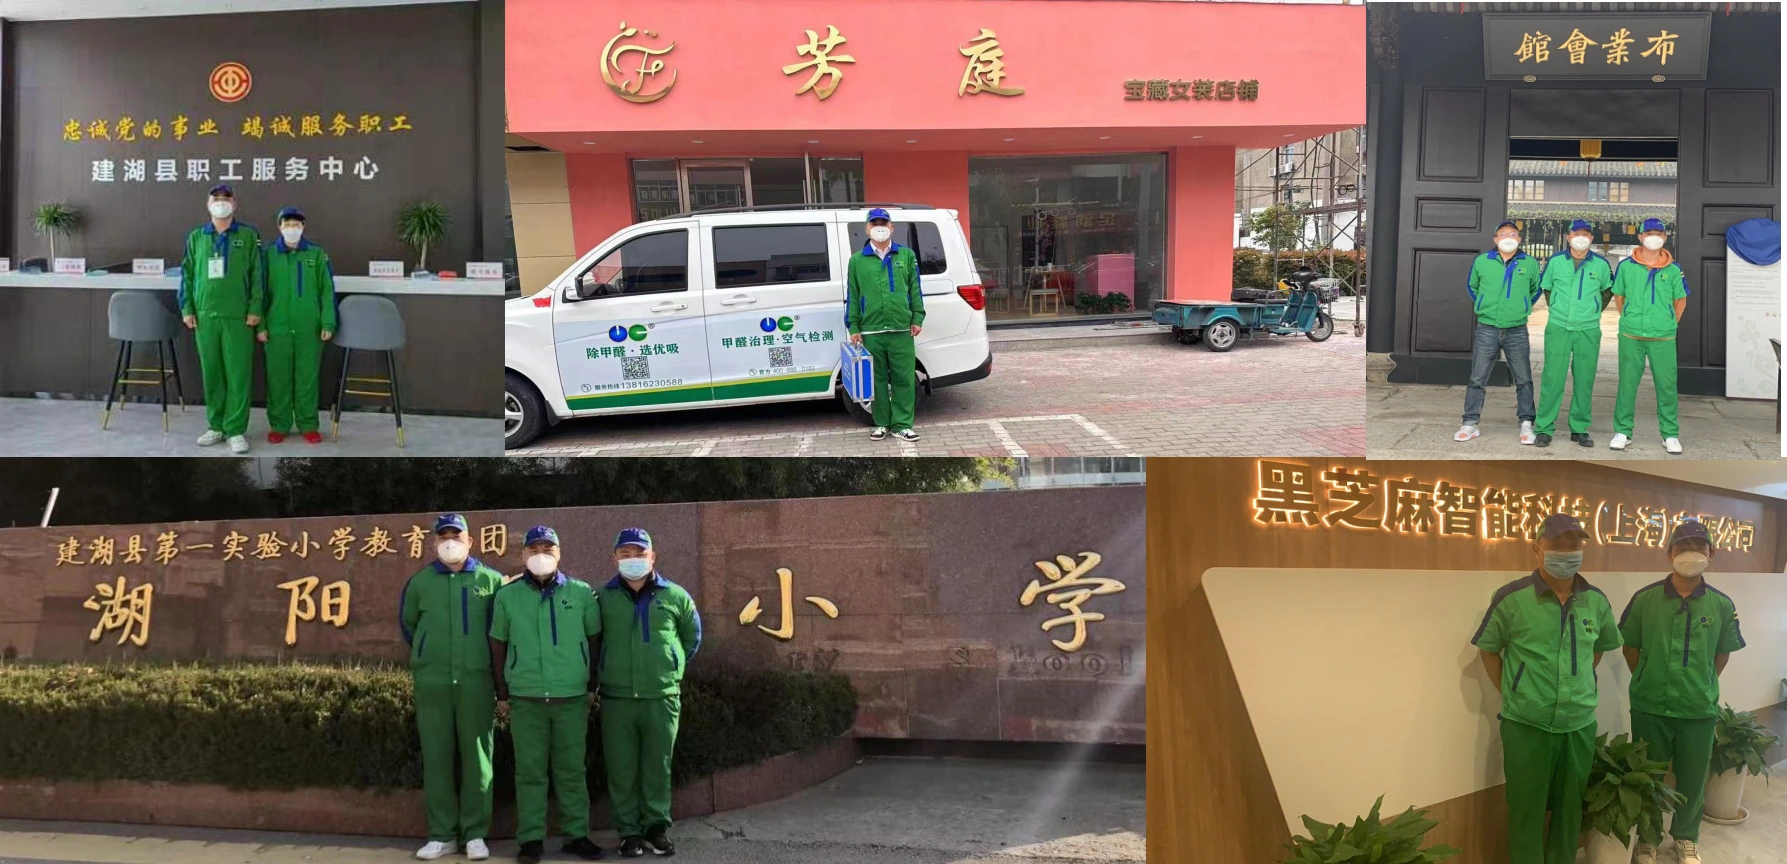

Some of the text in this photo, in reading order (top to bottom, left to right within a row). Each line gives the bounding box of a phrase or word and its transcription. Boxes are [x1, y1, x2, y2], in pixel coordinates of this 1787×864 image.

[1124, 79, 1259, 101] 宝藏女装店铺
[63, 114, 412, 142] 忠诚党的事业 竭诚服务职工
[91, 155, 379, 184] 建湖县职工服务中心
[56, 523, 508, 567] 建湖县第一实验小学教育团
